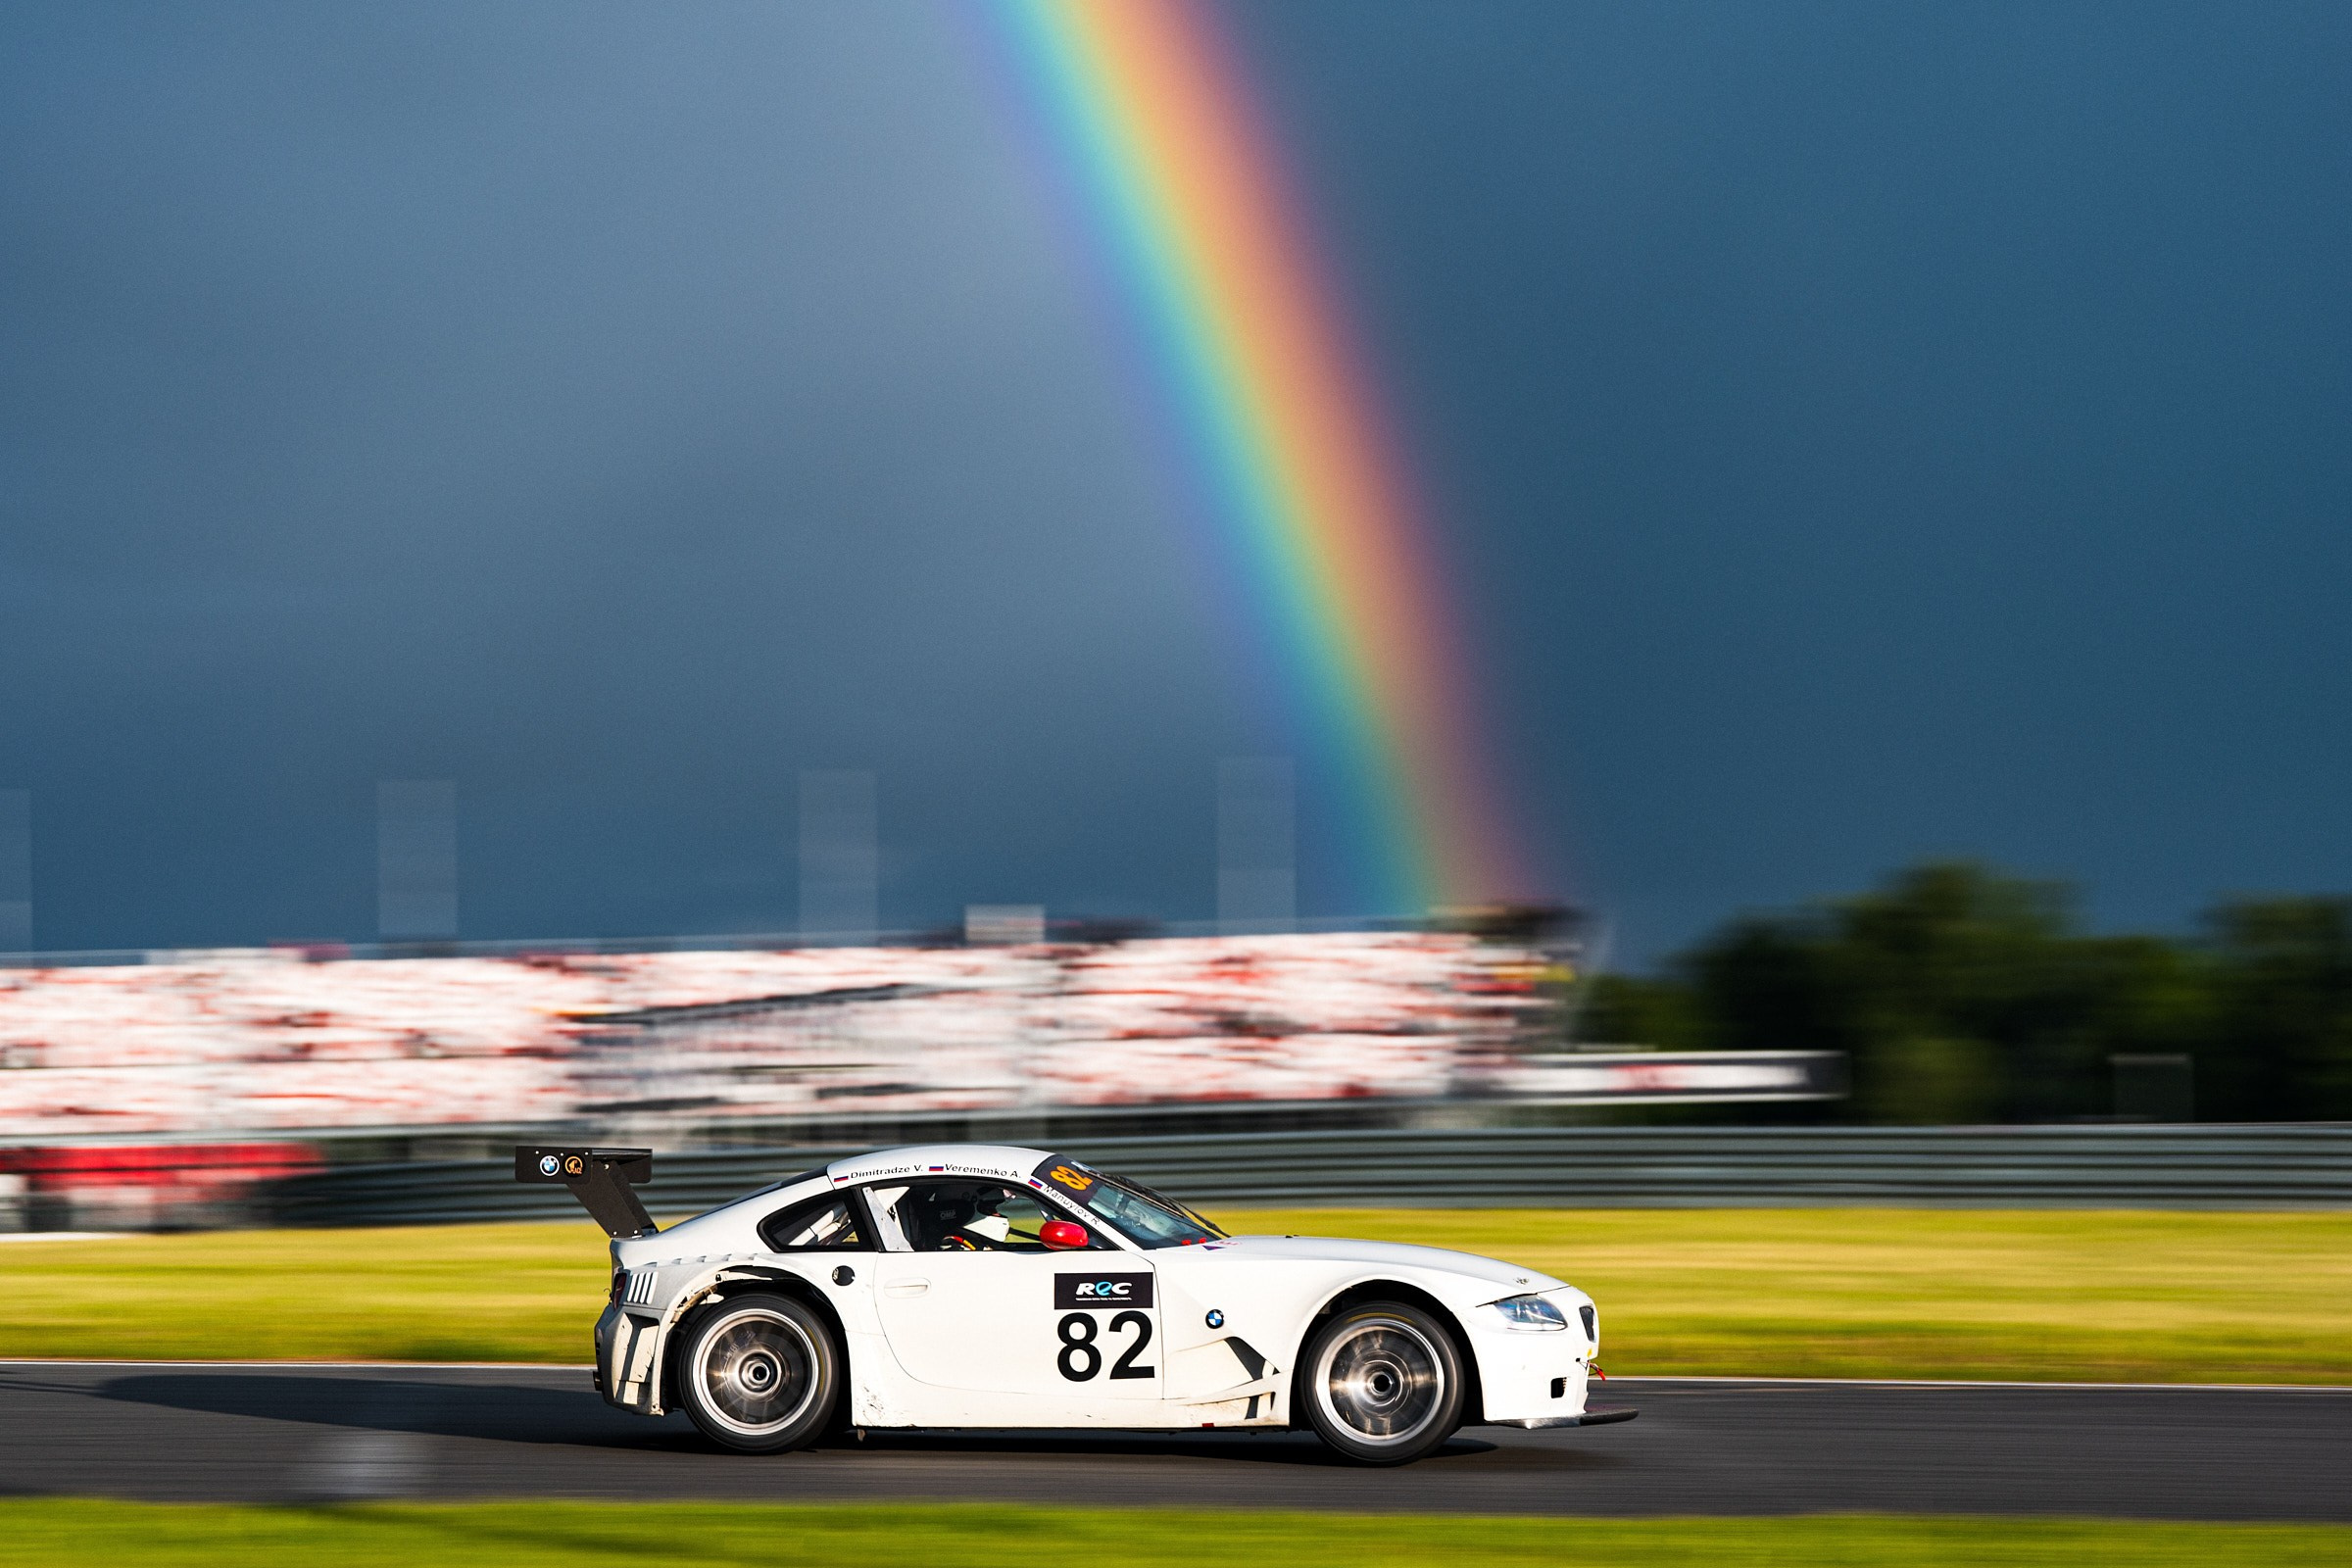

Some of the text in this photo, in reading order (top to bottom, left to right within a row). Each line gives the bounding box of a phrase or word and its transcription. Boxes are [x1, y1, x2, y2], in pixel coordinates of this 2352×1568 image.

[850, 1166, 909, 1179] Dimitradze
[945, 1163, 1021, 1179] Veremenko A.
[1050, 1165, 1094, 1191] 82
[1043, 1184, 1101, 1227] Manuylov R.
[1057, 1310, 1154, 1382] 82
